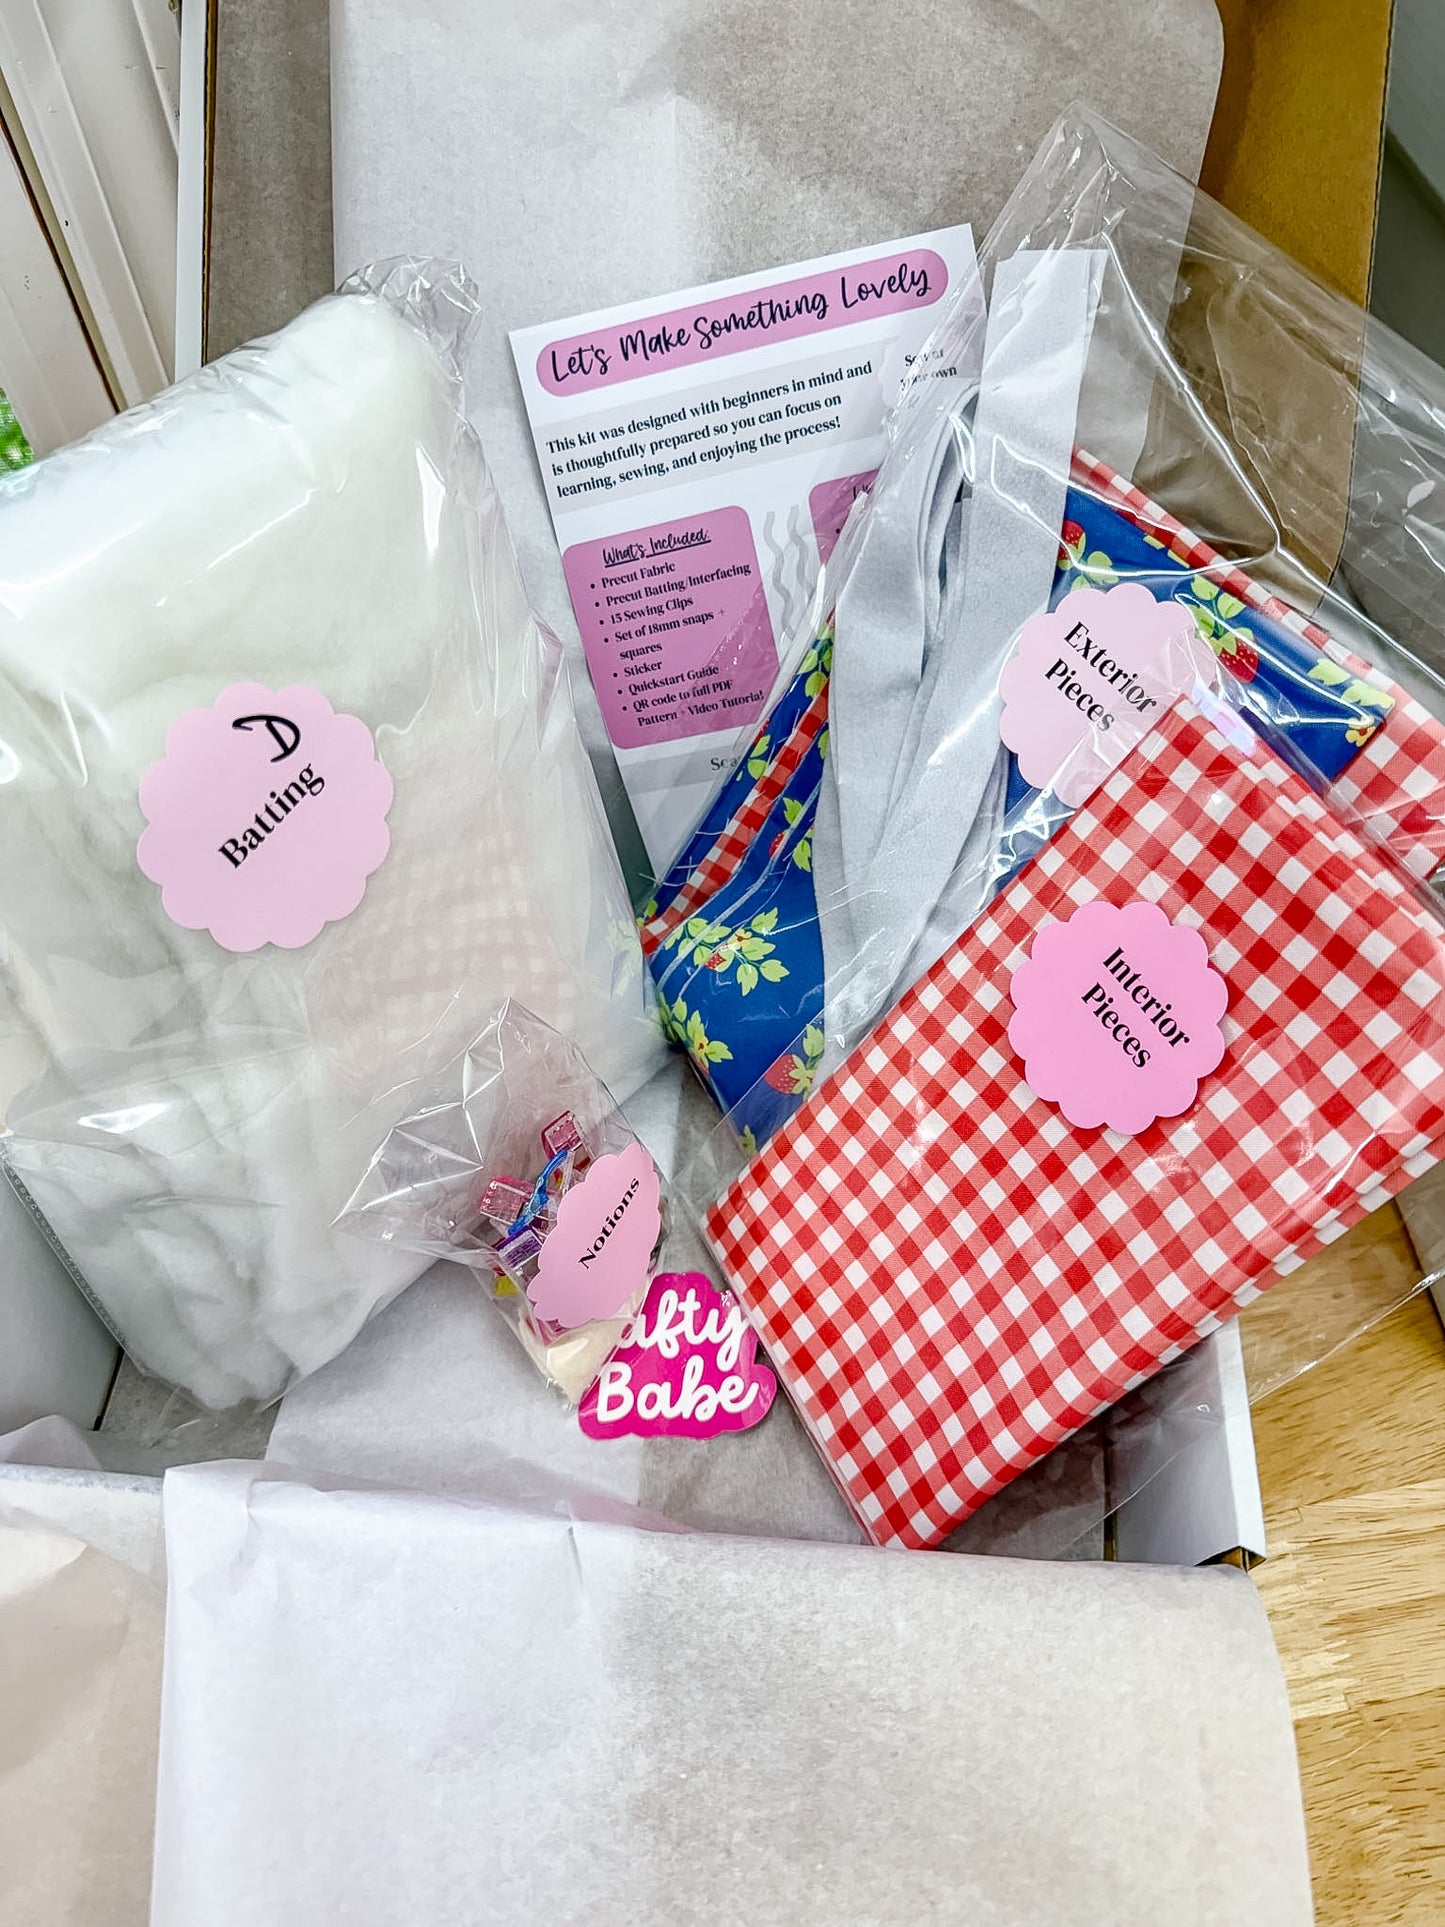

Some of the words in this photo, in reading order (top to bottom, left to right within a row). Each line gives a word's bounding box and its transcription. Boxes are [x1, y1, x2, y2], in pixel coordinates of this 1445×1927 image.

[551, 344, 612, 383] Let's
[620, 328, 691, 362] Make
[694, 290, 829, 350] Something
[841, 262, 933, 310] Lovely
[546, 437, 577, 454] This
[577, 430, 597, 447] kit
[599, 425, 626, 441] was
[627, 407, 688, 435] designed
[689, 399, 721, 418] with
[722, 383, 790, 410] beginners
[791, 378, 806, 393] in
[808, 367, 845, 389] mind
[846, 360, 873, 379] and
[551, 463, 564, 477] is
[566, 442, 647, 473] thoughtfully
[649, 425, 712, 456] prepared
[712, 423, 729, 437] so
[730, 416, 757, 435] you
[758, 409, 783, 425] can
[785, 401, 822, 418] focus
[824, 395, 843, 408] on
[556, 474, 617, 499] learning,
[618, 464, 670, 484] sewing,
[672, 451, 698, 470] and
[700, 437, 758, 462] enjoying
[759, 432, 782, 449] the
[784, 415, 842, 445] process!
[601, 572, 638, 589] Precut
[640, 561, 676, 579] Fabric
[602, 542, 647, 566] What's
[605, 590, 643, 607] Precut
[610, 613, 622, 626] 15
[623, 604, 664, 622] Sewing
[665, 596, 694, 612] Clips
[614, 629, 633, 643] Set
[635, 624, 647, 638] of
[647, 618, 681, 637] 18mm
[682, 610, 715, 629] snaps
[619, 641, 663, 661] squares
[623, 660, 663, 678] Sticker
[628, 673, 686, 697] Quickstart
[687, 665, 720, 681] Guide
[1063, 621, 1157, 714] Exterior
[632, 698, 650, 713] QR
[650, 692, 677, 708] code
[678, 690, 691, 702] to
[691, 685, 711, 700] full
[712, 679, 734, 695] PDF
[637, 710, 678, 728] Pattern
[687, 702, 719, 718] Video
[1044, 657, 1116, 733] Pieces
[231, 713, 302, 764] D
[217, 762, 326, 870] Batting
[1080, 981, 1152, 1069] Pieces
[1102, 945, 1191, 1049] Interior
[578, 1177, 641, 1271] Notions
[596, 1354, 760, 1424] Babe
